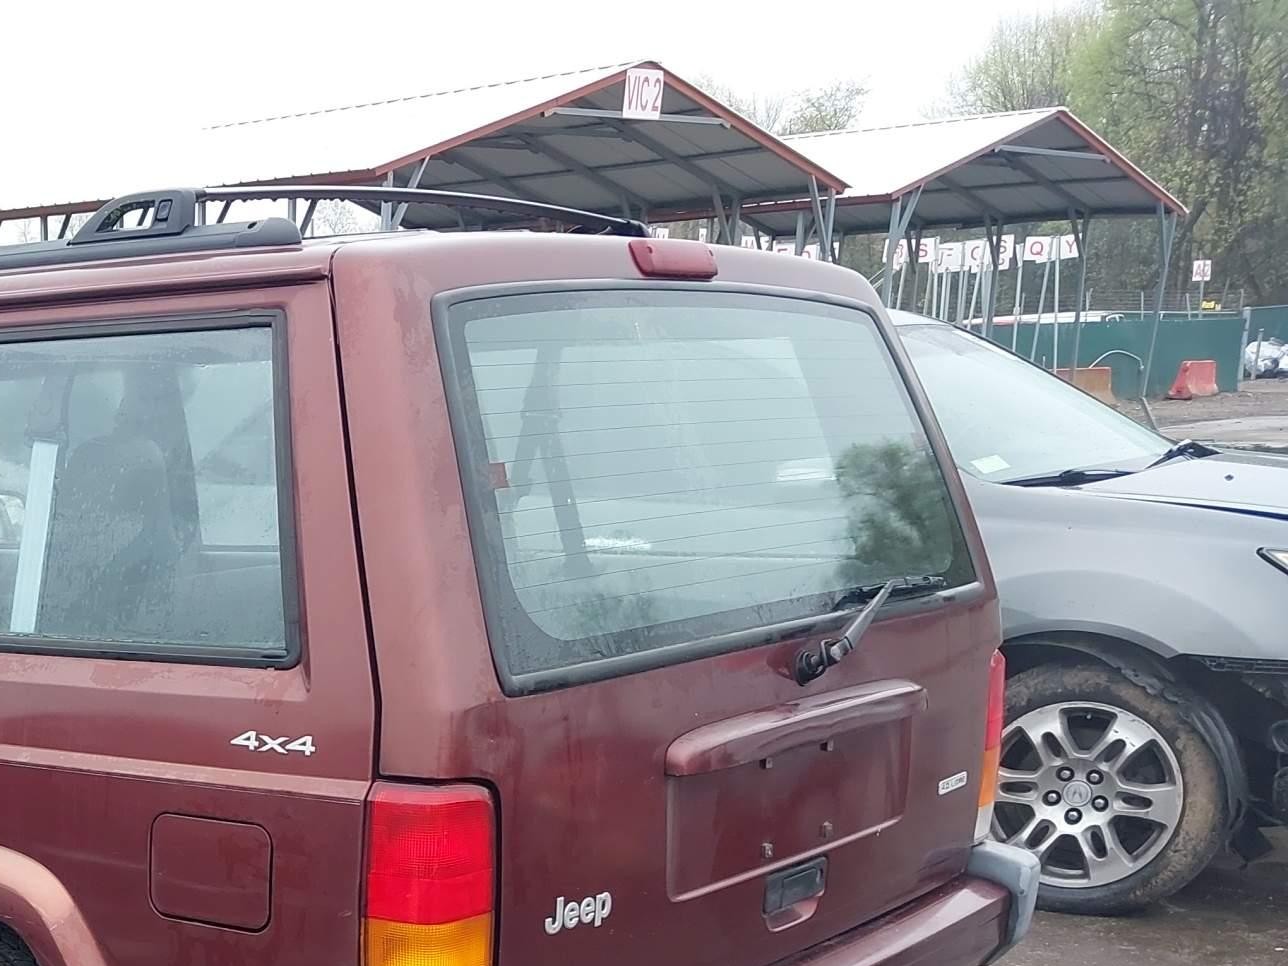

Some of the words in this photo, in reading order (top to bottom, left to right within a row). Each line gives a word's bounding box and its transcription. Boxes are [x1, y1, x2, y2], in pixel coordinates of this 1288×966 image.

[628, 75, 650, 111] VIC
[651, 78, 662, 112] 2
[1030, 241, 1043, 256] Q
[1066, 240, 1076, 254] Y
[545, 892, 612, 935] Jeep
